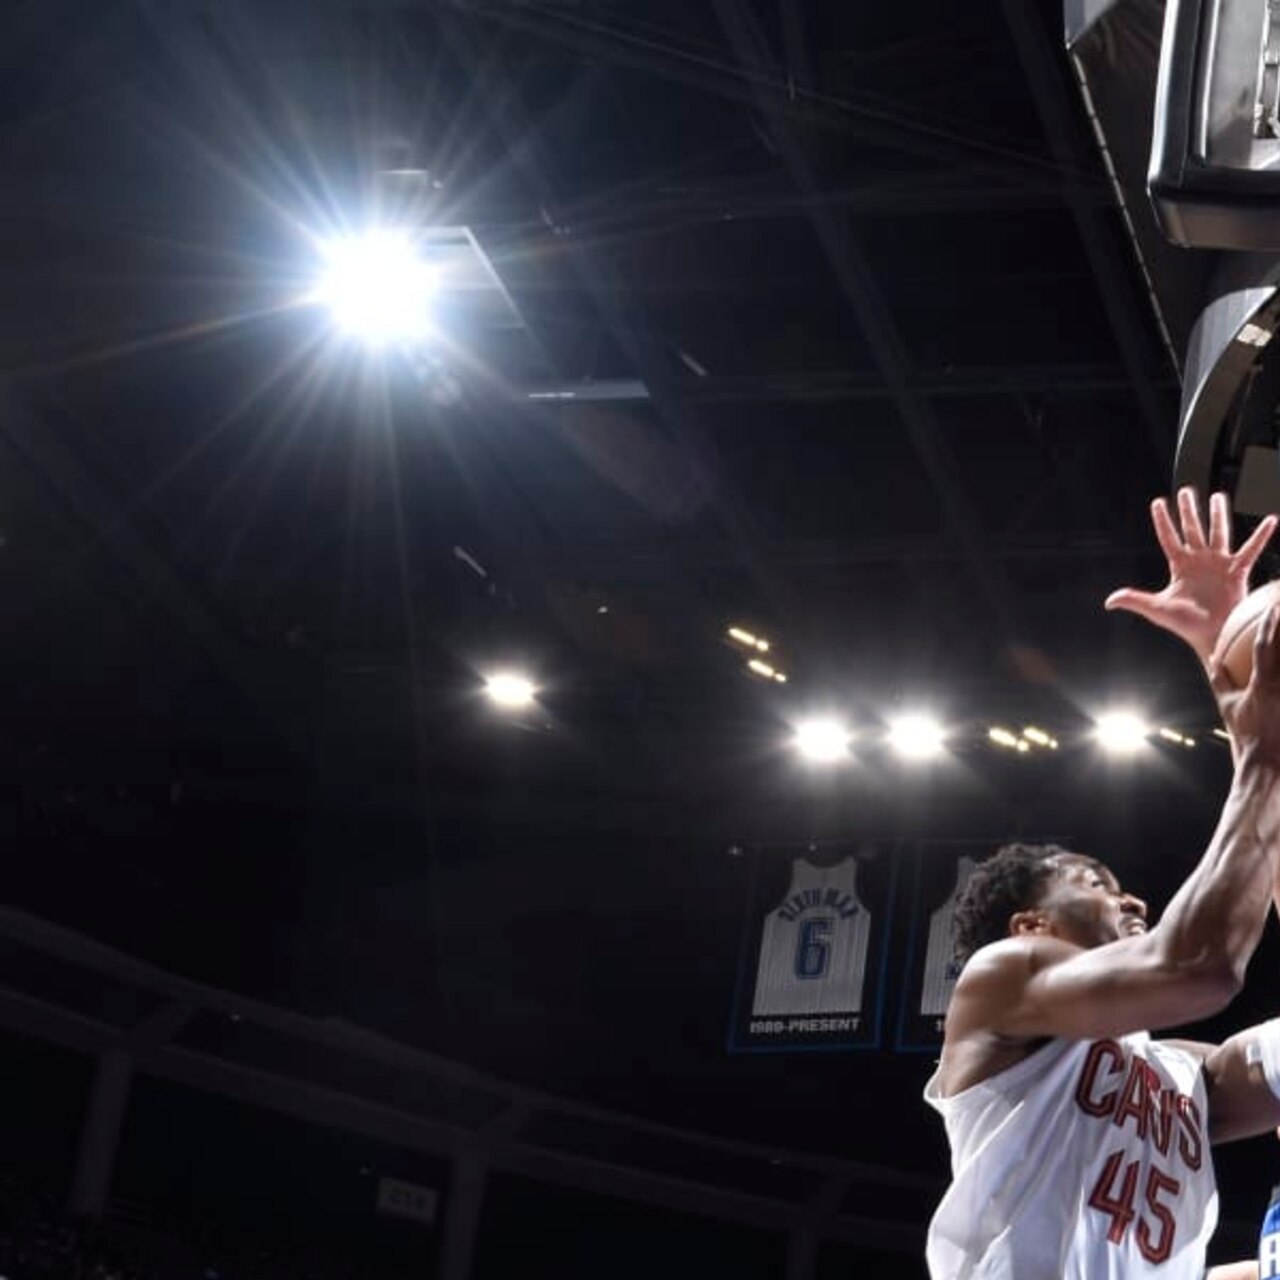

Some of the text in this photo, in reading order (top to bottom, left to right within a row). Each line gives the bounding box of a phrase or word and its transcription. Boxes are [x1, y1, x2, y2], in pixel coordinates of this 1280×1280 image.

[796, 917, 834, 979] 6
[1075, 1038, 1202, 1173] CAVS
[1088, 1150, 1180, 1266] 45
